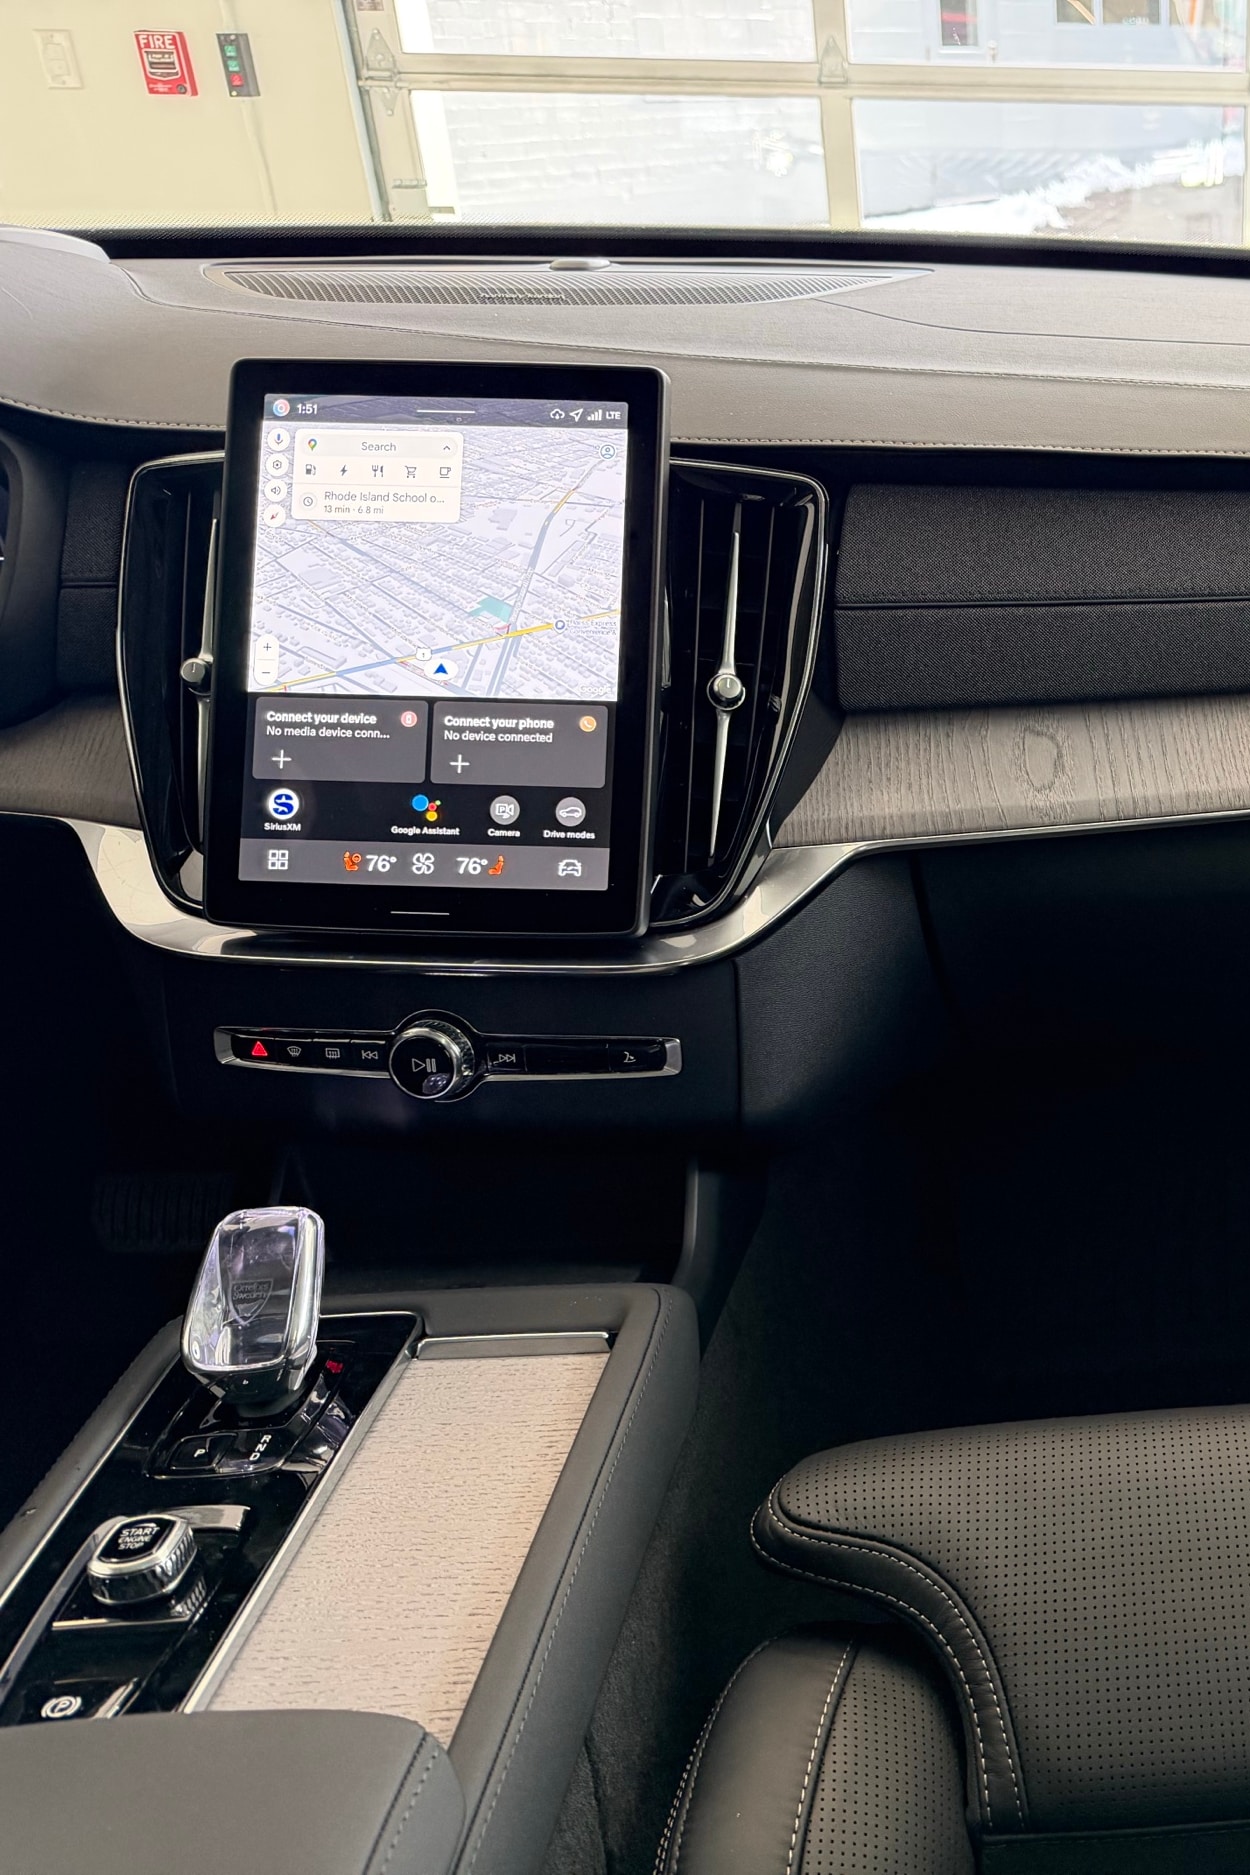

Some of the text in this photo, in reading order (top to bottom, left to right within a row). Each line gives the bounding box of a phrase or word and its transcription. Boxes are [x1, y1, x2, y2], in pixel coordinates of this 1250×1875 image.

[138, 34, 175, 49] FIRE
[296, 404, 318, 414] 1:51
[605, 411, 621, 420] LTE
[361, 441, 397, 452] Search
[324, 491, 357, 502] Rhode
[359, 492, 390, 502] Island
[392, 492, 427, 503] School
[324, 505, 333, 513] 13
[334, 505, 351, 514] min
[373, 506, 384, 515] mi
[266, 711, 377, 725] Connect your device
[444, 715, 555, 730] Connect your phone
[266, 725, 282, 736] No
[284, 727, 316, 737] media
[318, 727, 353, 738] device
[444, 730, 553, 743] No device connected
[264, 822, 301, 832] SiriusXM
[391, 825, 460, 836] Google Assistant
[487, 828, 521, 838] Camera
[543, 829, 596, 840] Drive modes
[366, 854, 397, 872] 76°
[456, 857, 488, 875] 76°
[193, 1448, 206, 1458] P
[120, 1526, 160, 1537] START
[117, 1534, 153, 1543] ENGINE
[117, 1542, 144, 1550] STOP
